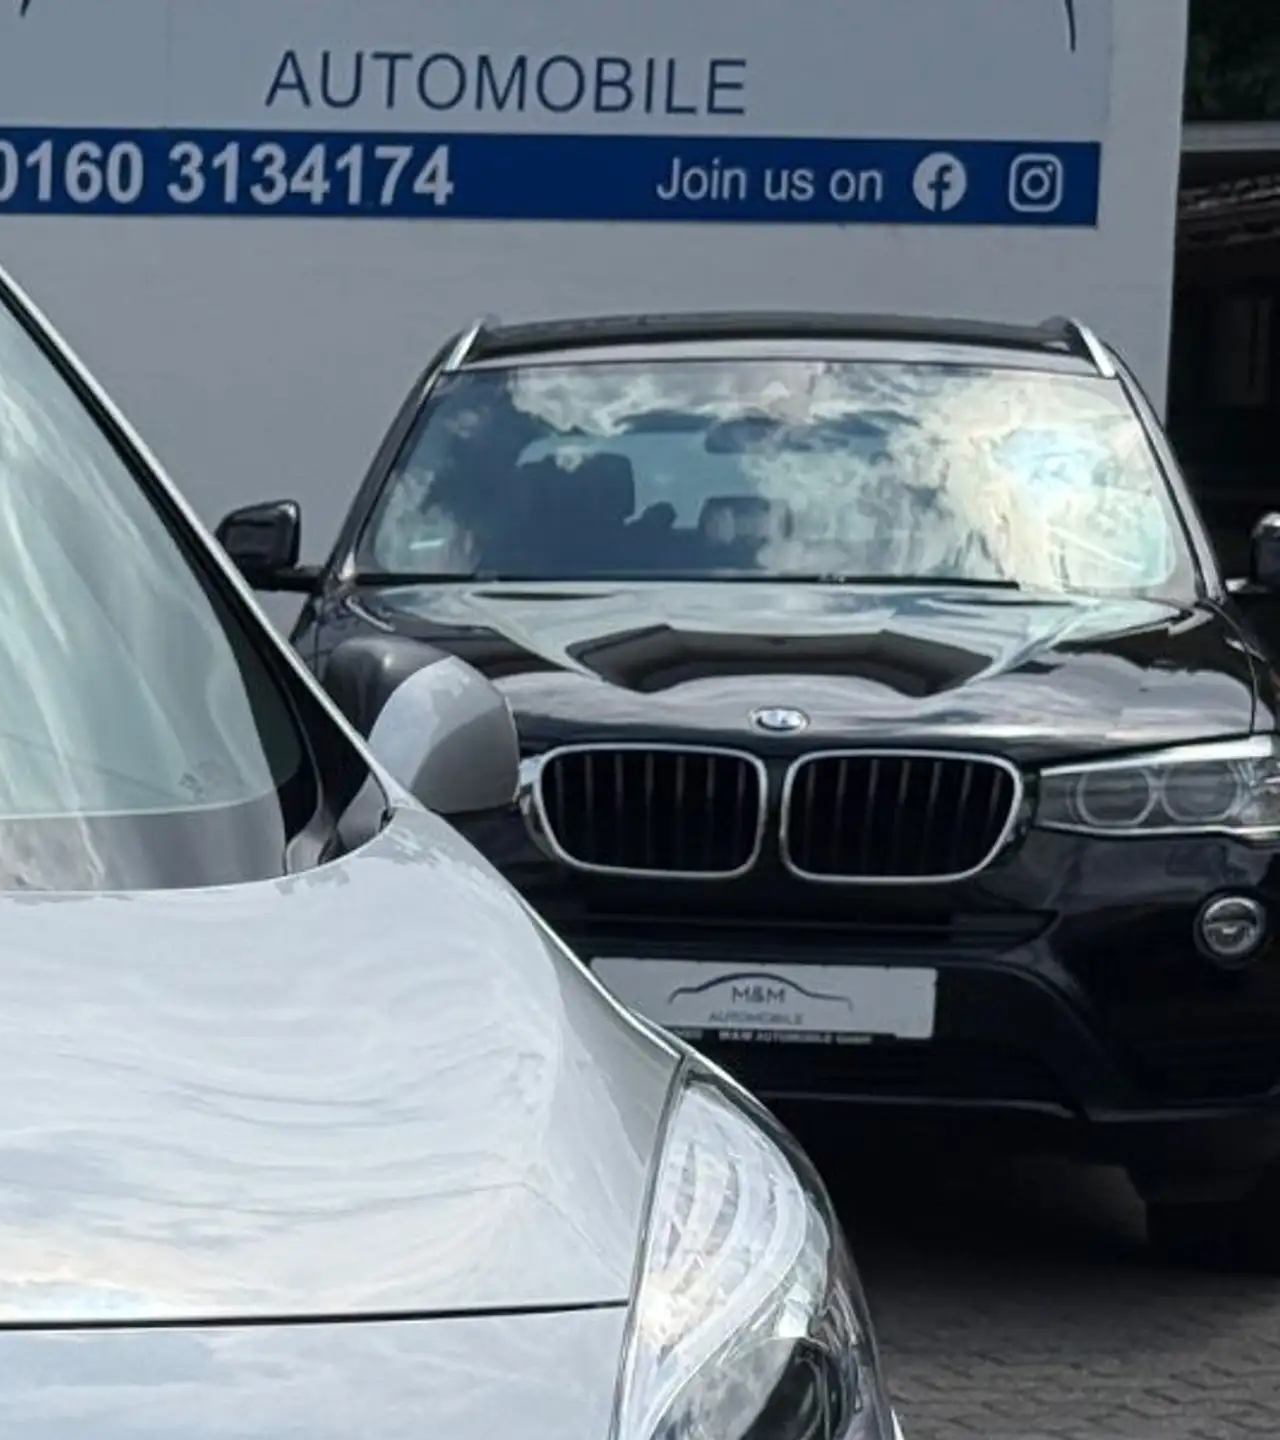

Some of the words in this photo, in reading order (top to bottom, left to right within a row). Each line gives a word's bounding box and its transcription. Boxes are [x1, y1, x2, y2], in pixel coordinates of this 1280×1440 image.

[264, 49, 747, 115] AUTOMOBILE
[166, 140, 455, 206] 3134174
[656, 157, 746, 200] Join
[763, 168, 815, 201] us
[829, 169, 883, 202] on
